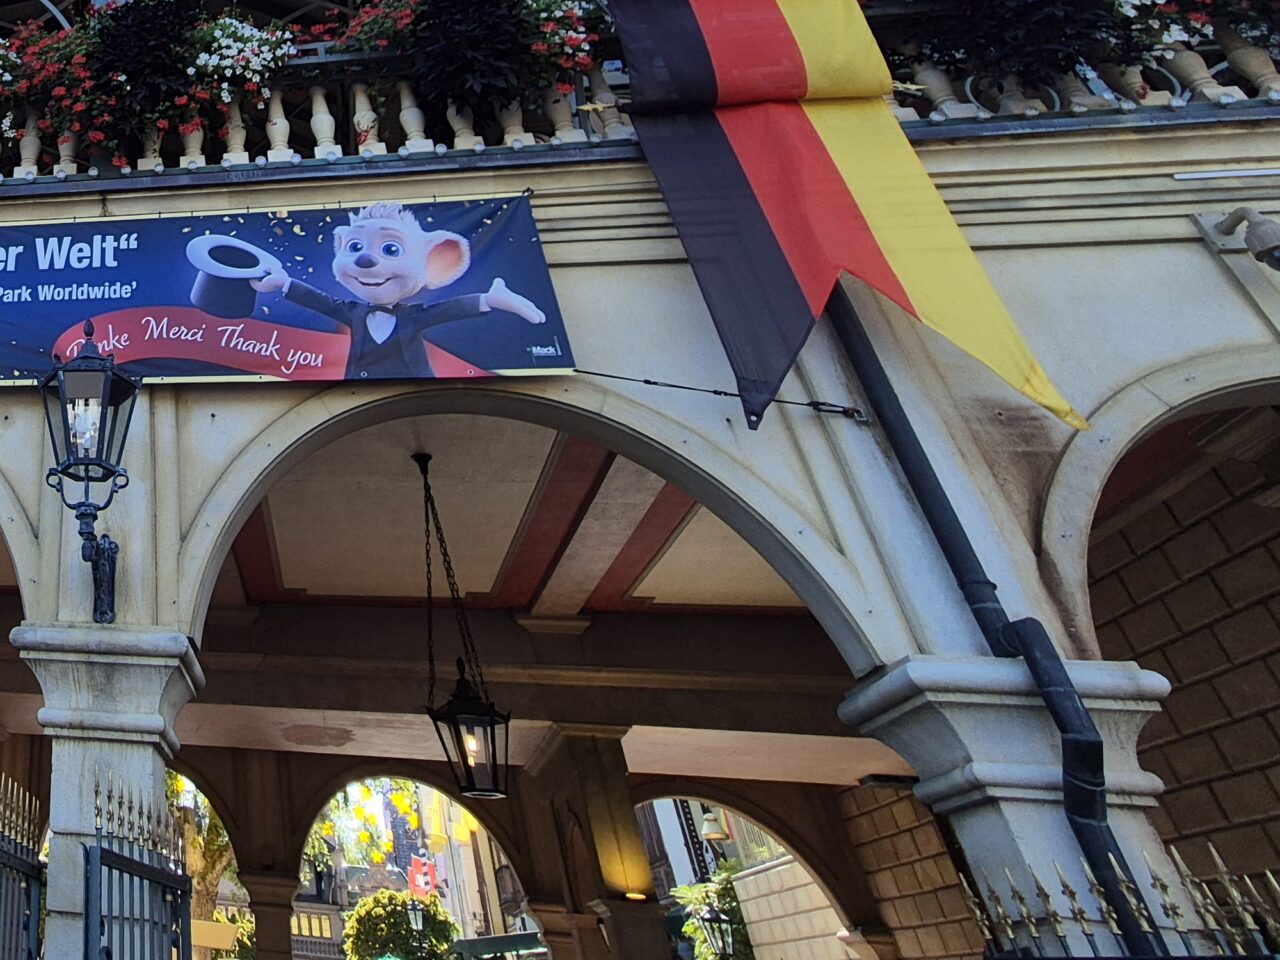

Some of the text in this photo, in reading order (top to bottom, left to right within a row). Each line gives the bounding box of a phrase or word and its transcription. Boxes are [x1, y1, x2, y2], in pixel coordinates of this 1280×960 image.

[66, 316, 324, 375] Dnke Merci Thank you
